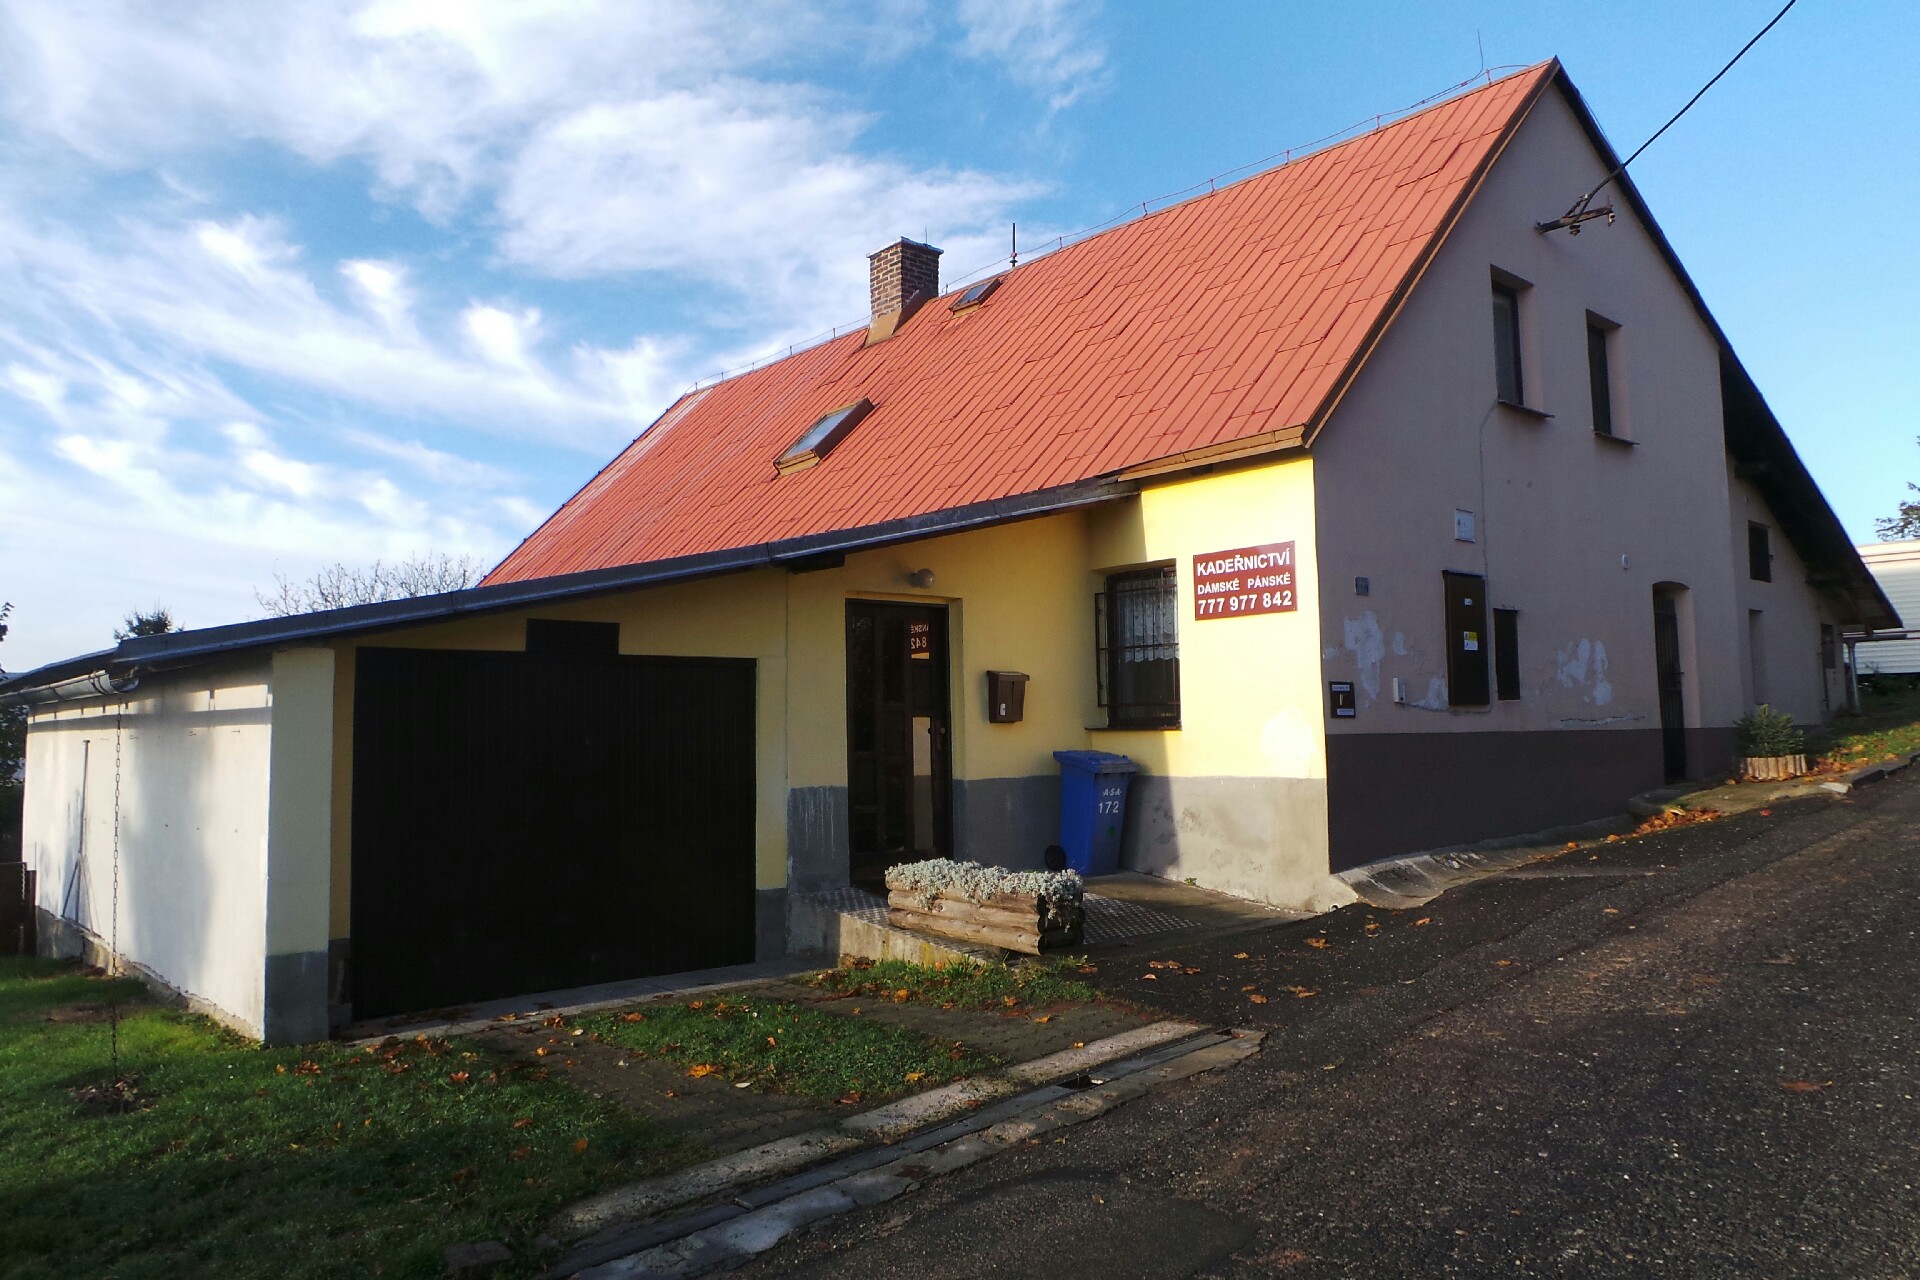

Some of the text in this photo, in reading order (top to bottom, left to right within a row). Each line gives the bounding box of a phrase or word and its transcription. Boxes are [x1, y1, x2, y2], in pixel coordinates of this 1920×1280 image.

[1197, 548, 1290, 576] KADEŘNICTVÍ
[1197, 572, 1291, 595] DÁMSKÉ PÁNSKÉ
[1198, 590, 1292, 614] 777 977 842
[1099, 801, 1119, 814] 172
